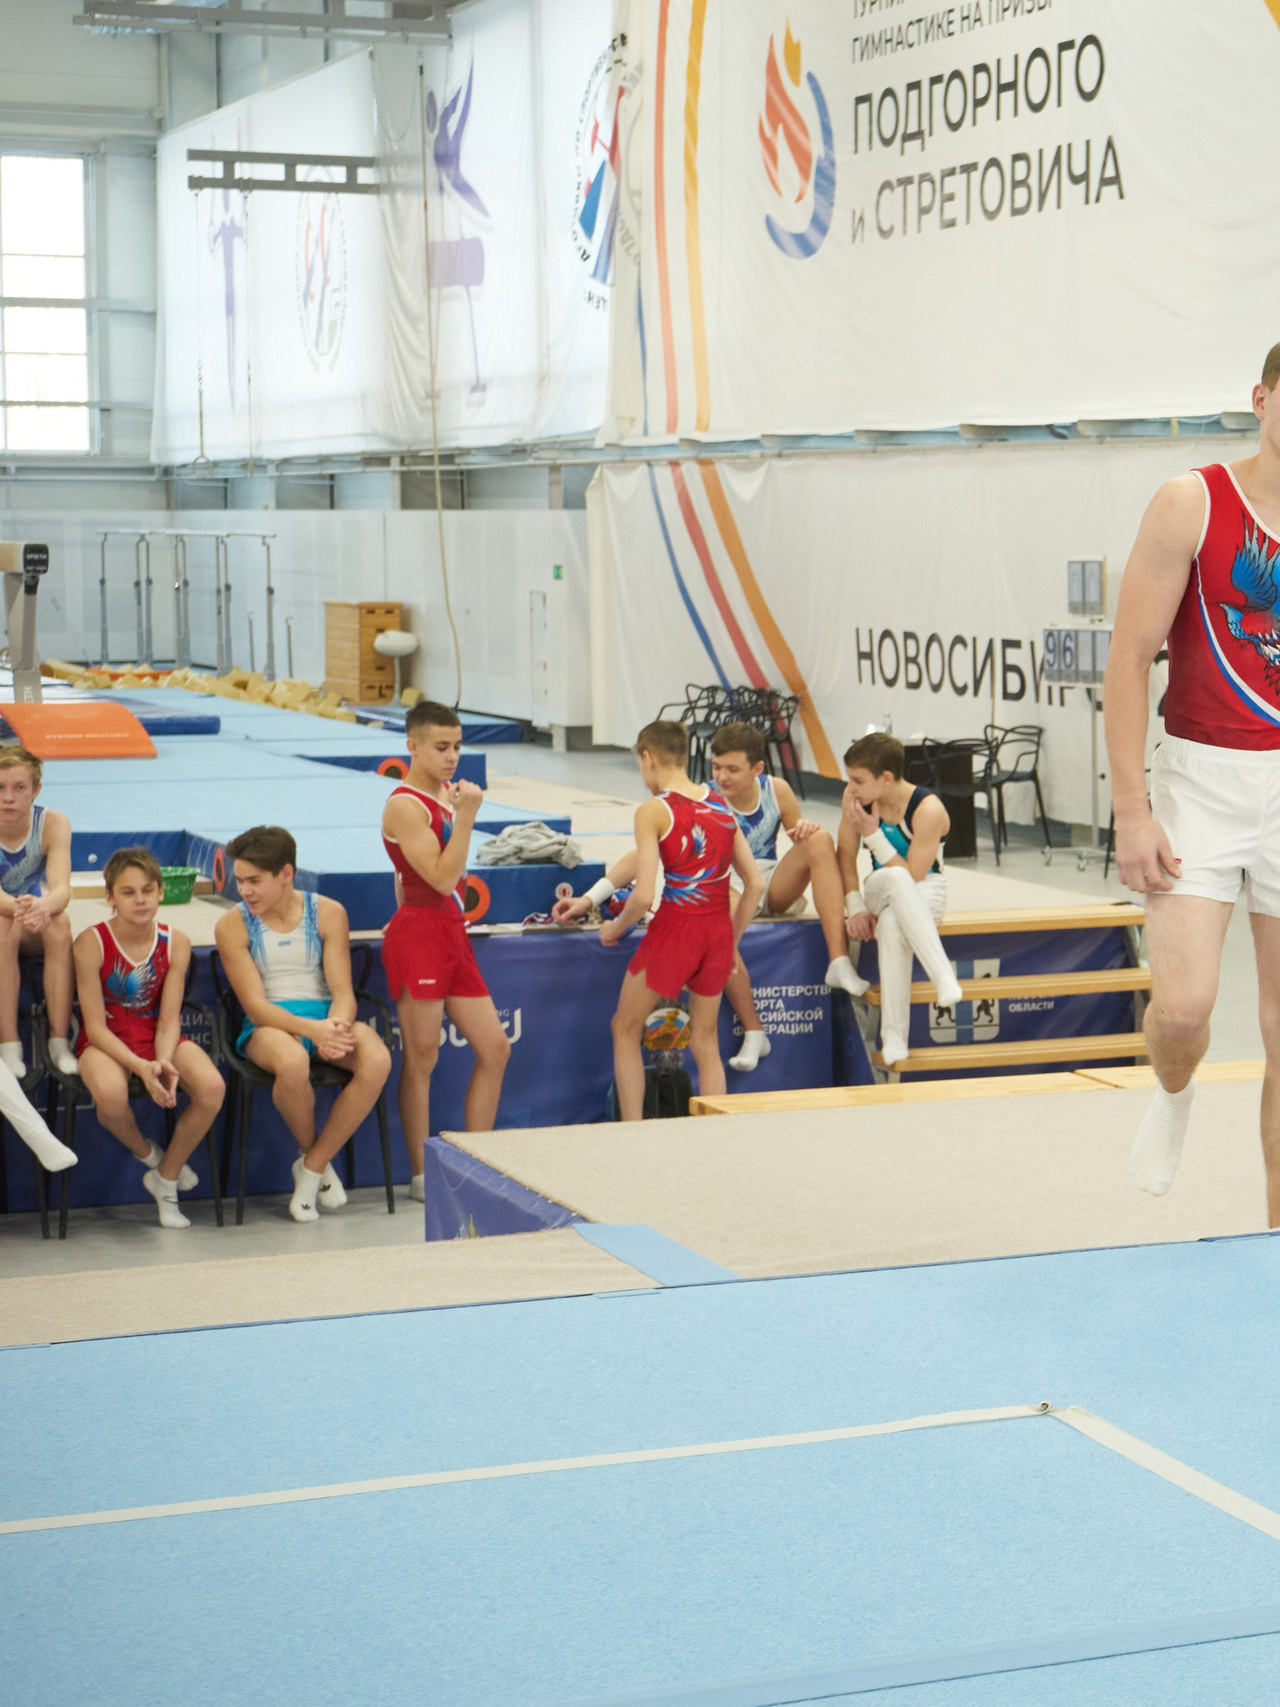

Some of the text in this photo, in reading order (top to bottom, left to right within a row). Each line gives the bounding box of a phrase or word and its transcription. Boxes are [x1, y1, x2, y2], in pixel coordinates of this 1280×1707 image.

[852, 8, 954, 64] ГИМНАСТИКЕ
[960, 1, 984, 34] НА
[854, 34, 1105, 156] ПОДГОРНОГО
[852, 135, 1124, 244] и СТРЕТОВИЧА
[1045, 632, 1073, 668] 96
[751, 985, 831, 998] НИСТЕРСТВ
[733, 1006, 823, 1024] РСИЙСКОЙ
[1009, 1001, 1054, 1013] ОБЛАСТИ
[733, 1023, 814, 1037] ФЕРАЦИИ
